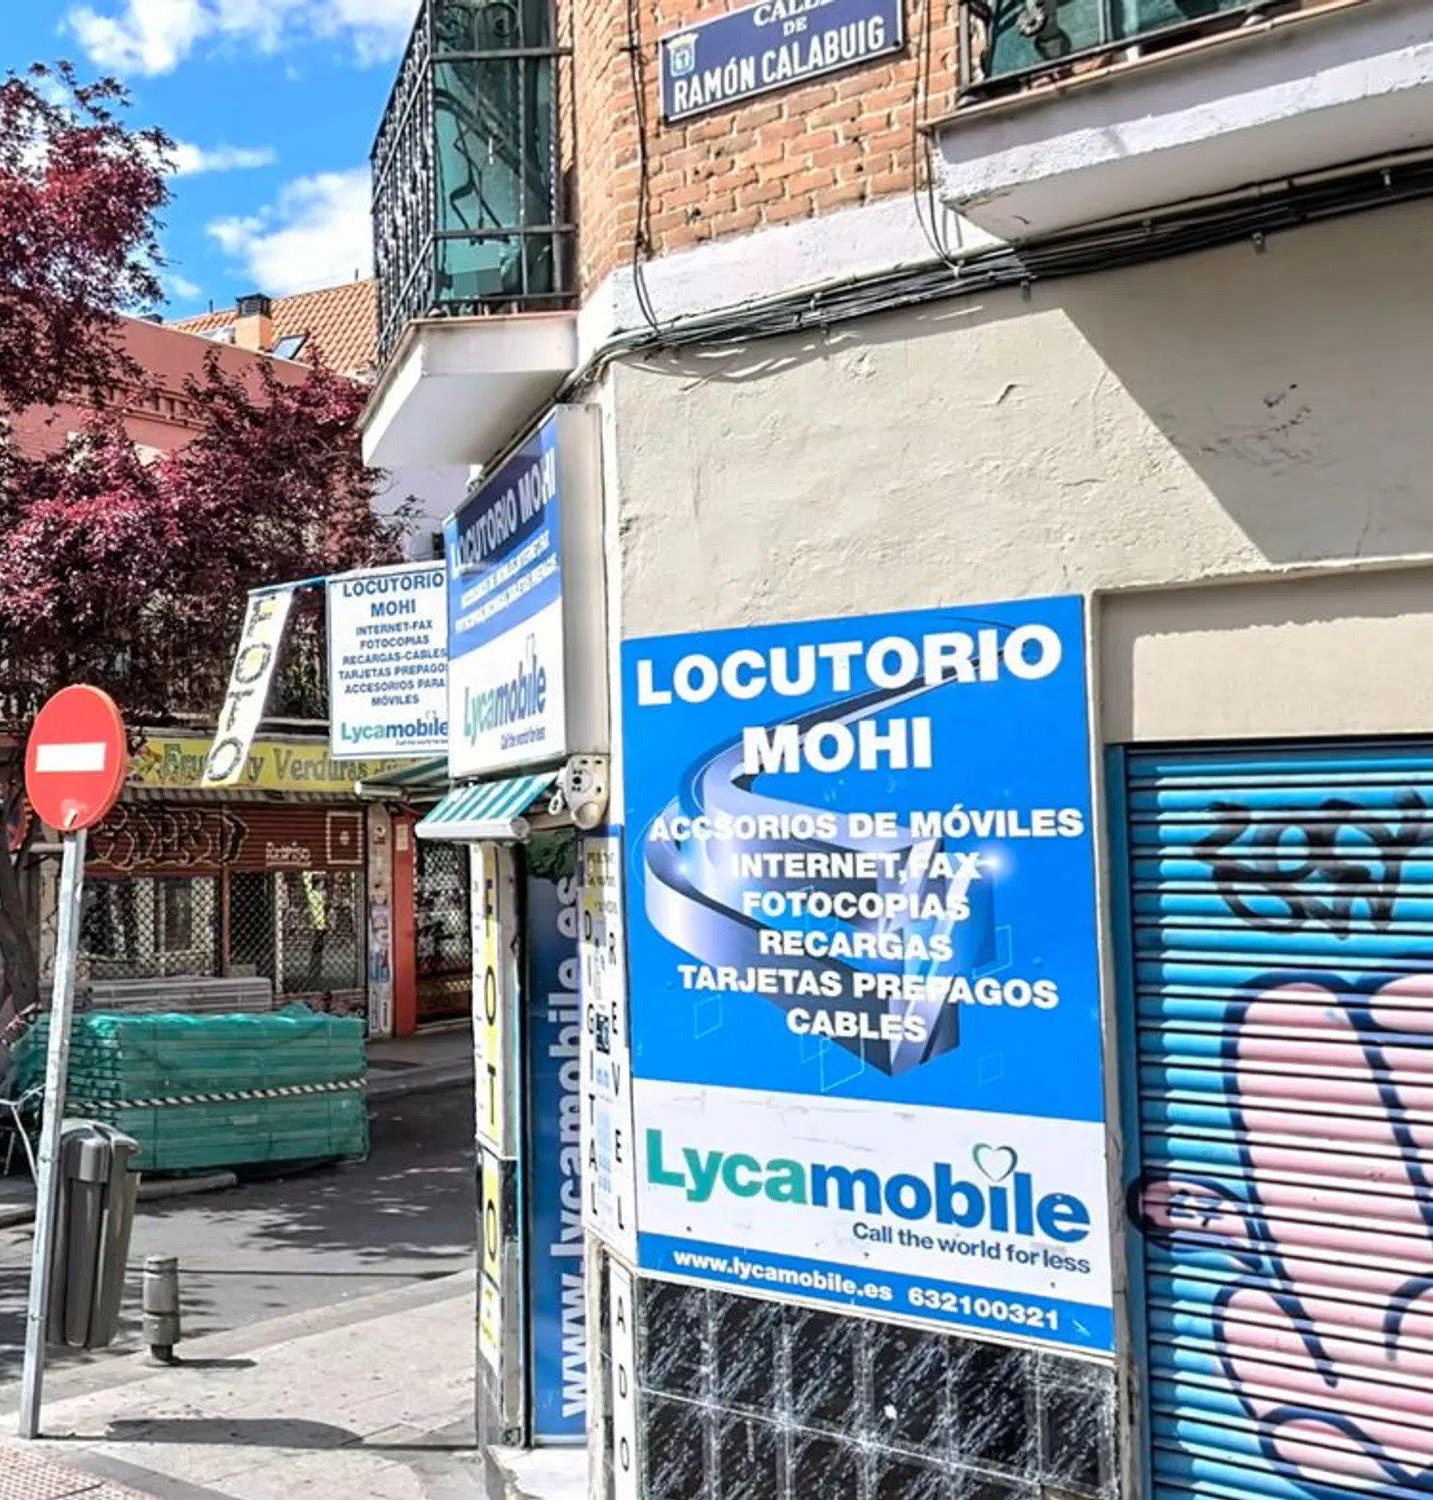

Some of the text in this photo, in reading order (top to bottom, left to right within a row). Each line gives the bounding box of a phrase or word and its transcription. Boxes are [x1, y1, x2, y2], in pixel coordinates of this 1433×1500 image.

[750, 0, 834, 26] CALL
[782, 15, 808, 37] DE
[674, 15, 886, 113] RAMÓN CALABUIG
[517, 447, 556, 525] MOHI
[342, 572, 445, 598] LOCUTORIO
[370, 598, 416, 618] MOHI
[355, 619, 434, 636] INTERNET-FAX
[359, 634, 430, 650] FOTOCOPIAS
[338, 667, 392, 680] TARJETAS
[637, 623, 1062, 706] LOCUTORIO
[207, 595, 273, 781] FOTO
[344, 678, 446, 694] ACCESORIOS PARA
[463, 653, 547, 748] Lycamobile
[340, 716, 448, 744] Lycamobile
[742, 716, 933, 776] MOHI
[273, 748, 367, 781] Verduras
[649, 804, 1084, 843] ACCSORIOS DE MÓVILES
[742, 891, 970, 921] FOTOCOPIAS
[758, 929, 954, 962] RECARGAS
[677, 964, 1060, 1009] TARJETAS PREPAGOS
[785, 1007, 927, 1043] CABLES
[583, 909, 599, 1215] DIGITAL
[645, 1127, 1091, 1244] Lycamobile
[852, 1221, 1091, 1274] Call the world for less
[672, 1249, 1061, 1331] www.lycamobile.es 632100321
